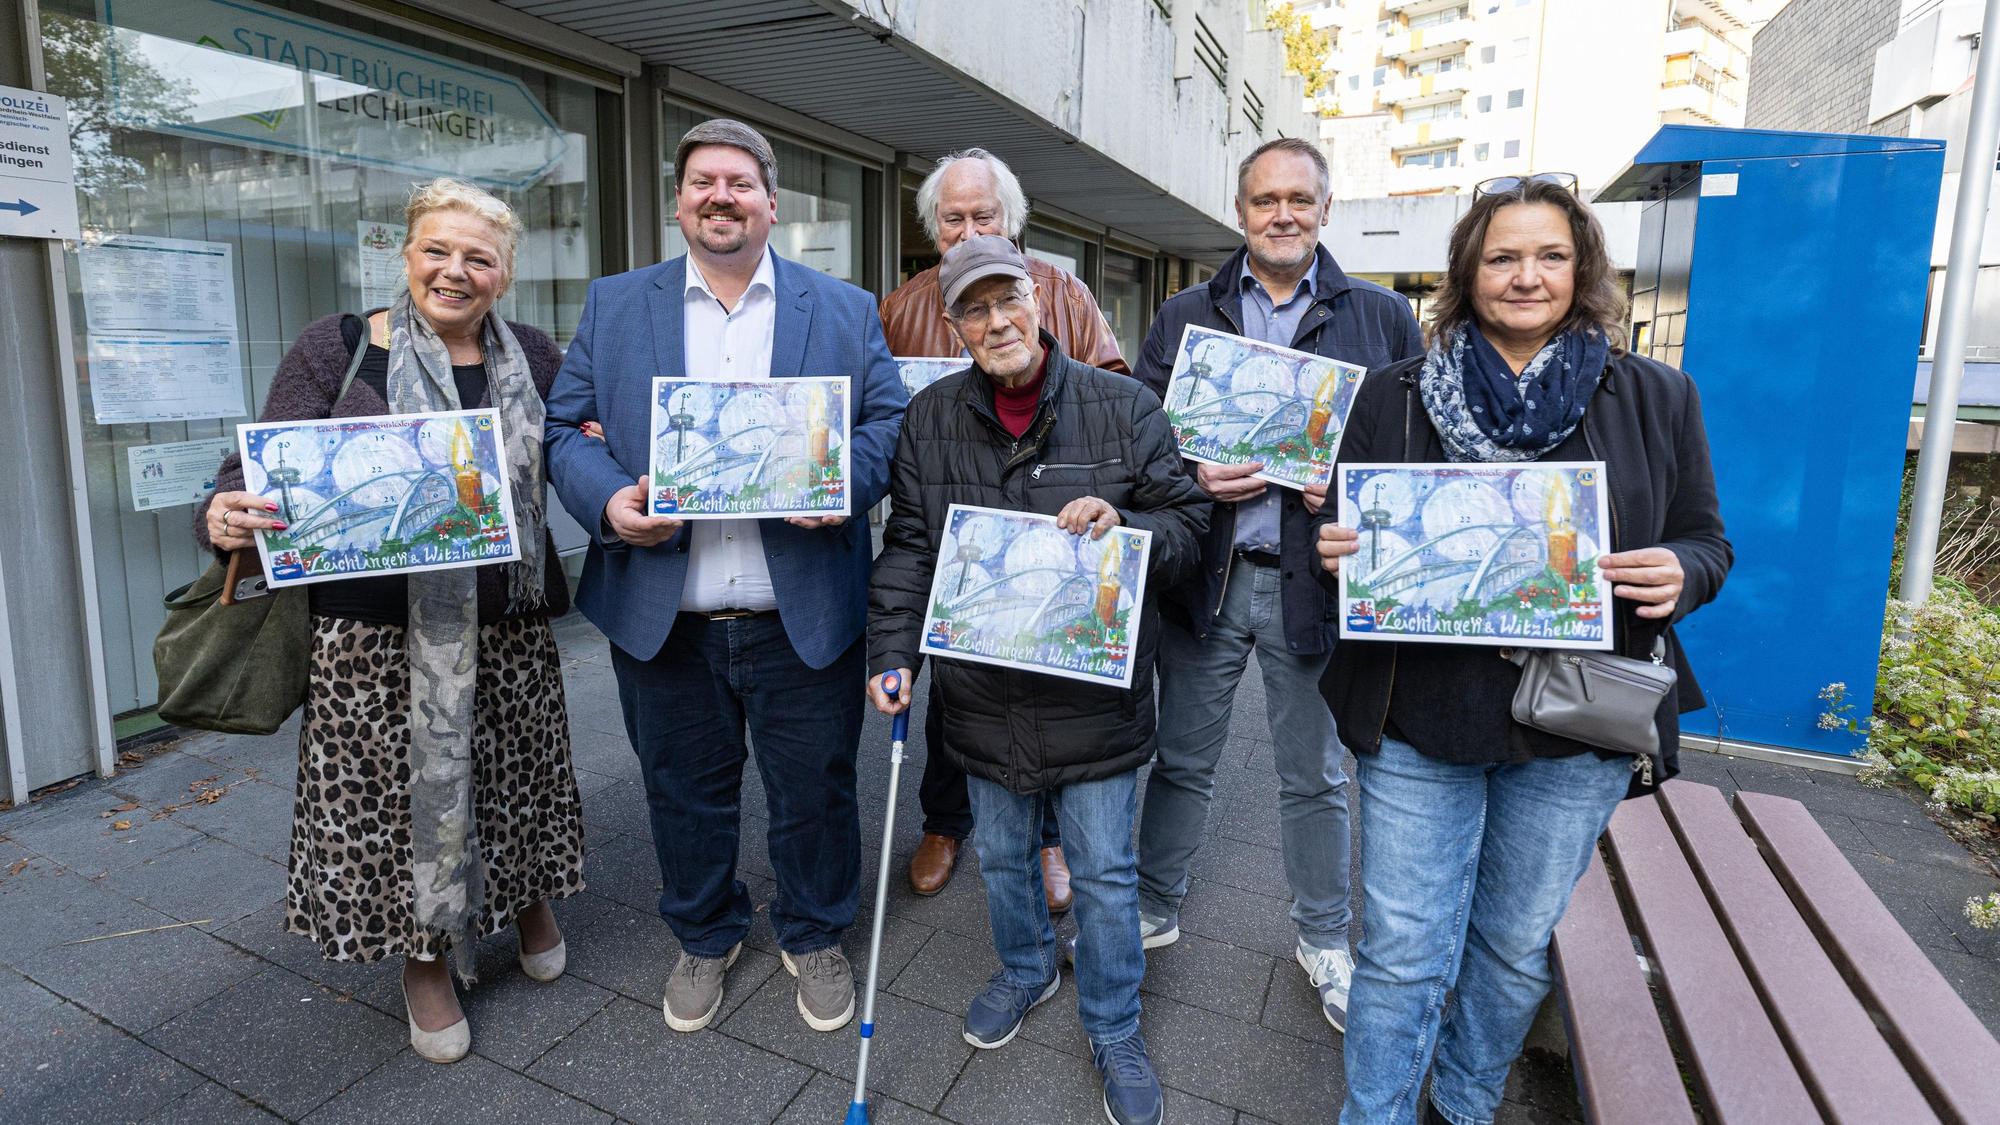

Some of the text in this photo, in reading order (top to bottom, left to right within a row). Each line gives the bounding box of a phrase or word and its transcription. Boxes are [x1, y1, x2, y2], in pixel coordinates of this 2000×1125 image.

[233, 27, 494, 116] STADTBÜCHEREI
[0, 96, 49, 113] OLIZEI
[317, 92, 495, 144] LEICHLINGEN
[375, 434, 386, 442] 15
[421, 431, 431, 439] 21
[277, 441, 291, 449] 20
[371, 465, 383, 474] 22
[384, 495, 396, 503] 23
[762, 500, 769, 509] &
[1459, 516, 1471, 524] 22
[439, 533, 450, 541] 24
[1468, 549, 1479, 557] 23
[411, 554, 421, 564] &
[1484, 622, 1496, 634] &
